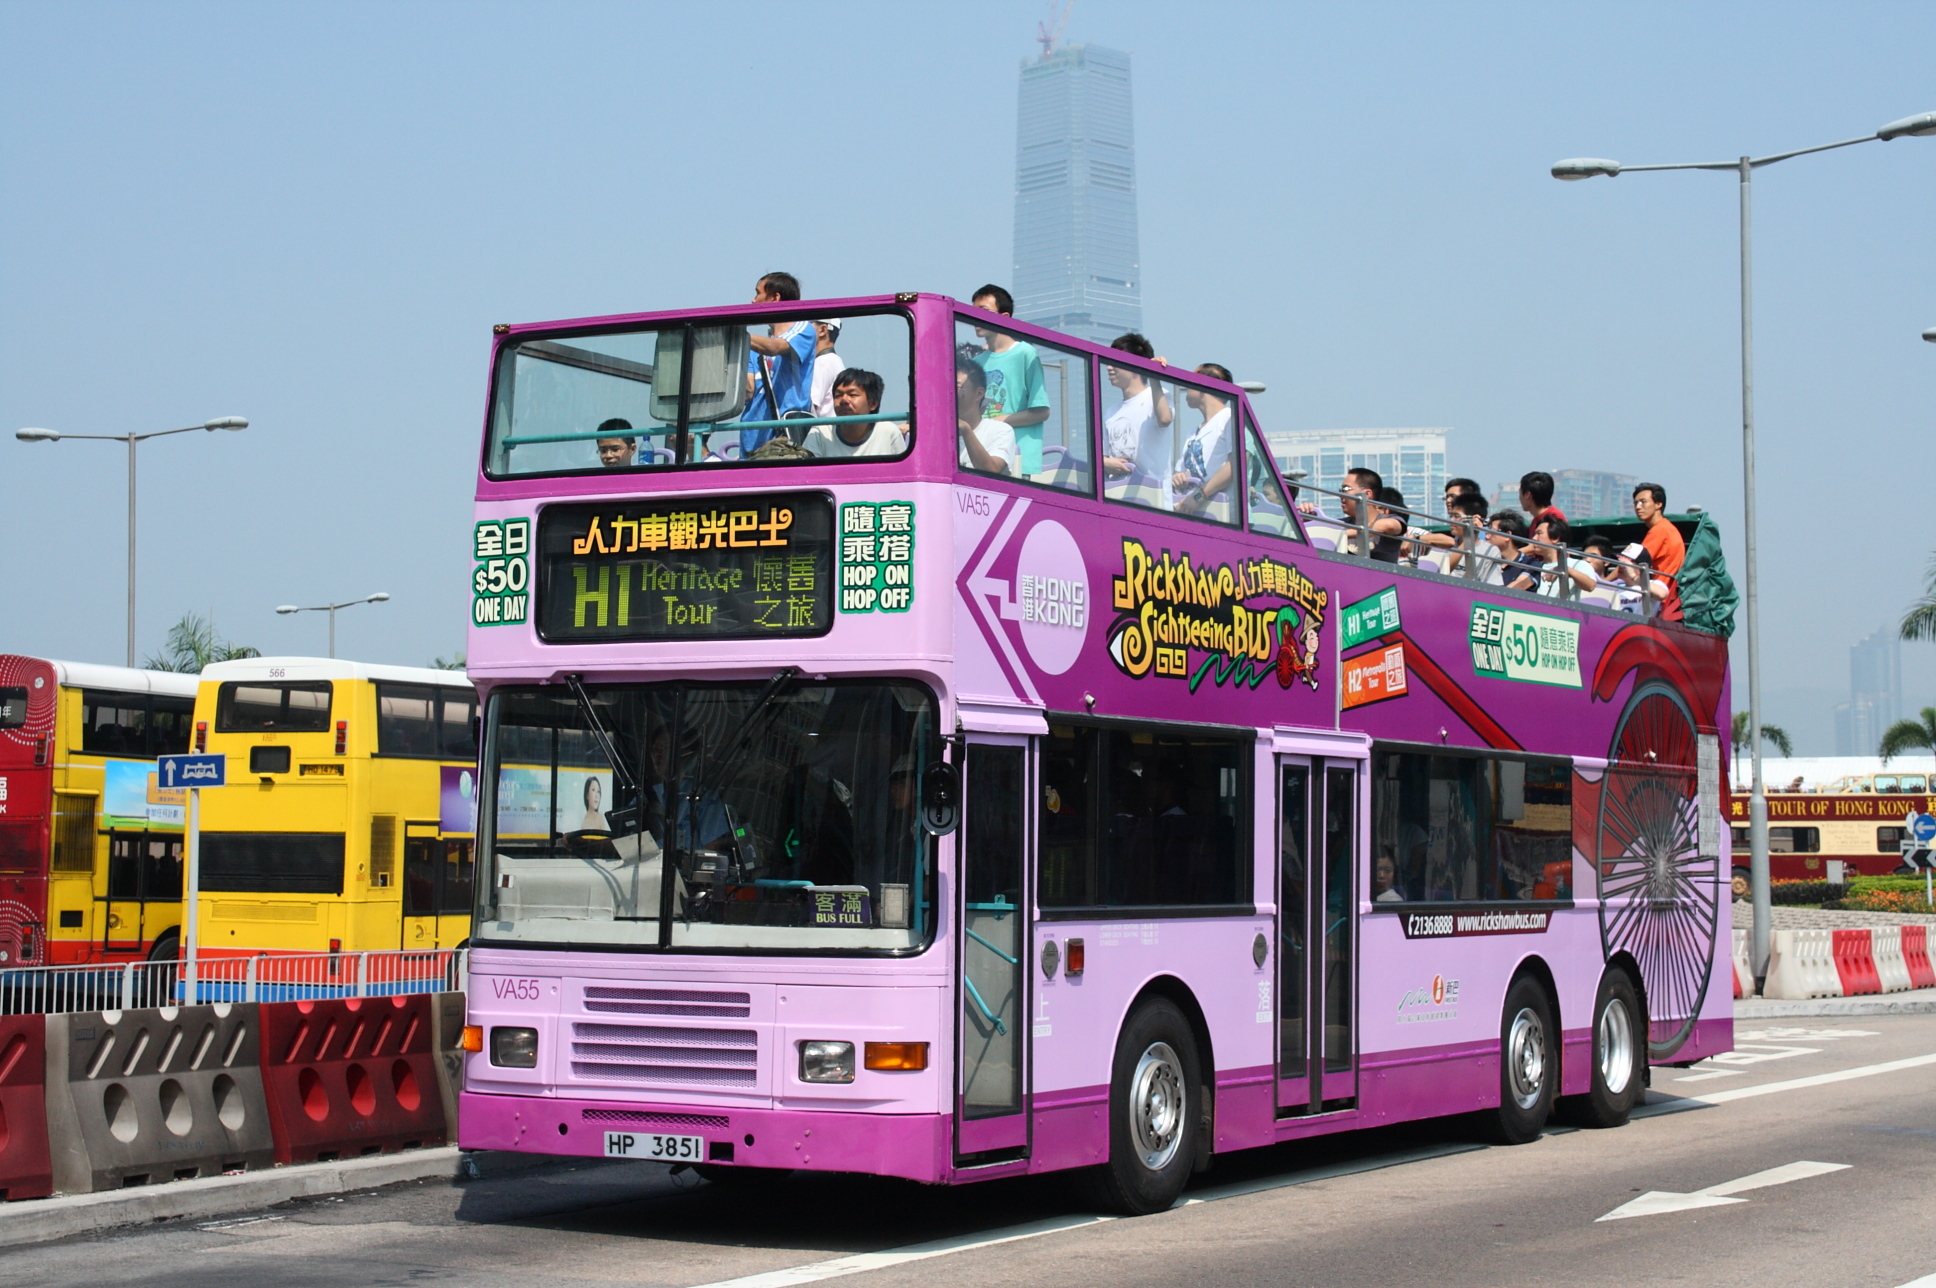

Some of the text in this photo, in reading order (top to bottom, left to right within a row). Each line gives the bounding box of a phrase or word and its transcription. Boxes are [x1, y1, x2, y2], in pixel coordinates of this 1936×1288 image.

[957, 491, 990, 516] VA55
[573, 508, 793, 555] 人力車觀光巴士
[844, 505, 911, 533] 隨意
[477, 522, 528, 557] 全日
[843, 535, 911, 562] 乘搭
[475, 557, 527, 594] $50
[641, 562, 743, 593] Heritage
[843, 565, 909, 586] HOP ON
[1114, 541, 1234, 609] Rickshaw
[843, 588, 910, 609] HOP OFF
[1035, 575, 1084, 604] HONG
[1235, 558, 1328, 622] 人力車觀光巴士
[475, 595, 527, 623] ONE DAY
[663, 596, 718, 625] Tour
[753, 594, 816, 627] 之旅
[1035, 599, 1084, 628] KONG
[1123, 601, 1278, 676] Sightseeing BUS
[1348, 613, 1360, 636] H1
[1471, 607, 1504, 642] 全日
[1472, 642, 1491, 670] ONE
[1505, 623, 1539, 668] $50
[269, 668, 286, 678] 566
[1348, 668, 1362, 693] H2
[1769, 801, 1807, 816] TOUR
[1811, 801, 1829, 816] OF
[1835, 800, 1873, 816] HONG
[1878, 800, 1915, 816] KONG
[815, 893, 862, 913] 客滿
[816, 913, 863, 924] BUS FULL
[1457, 911, 1546, 932] www.rickshawbus.com
[492, 978, 540, 1000] VA55
[1258, 980, 1271, 1011] 落
[1035, 992, 1050, 1021] 上
[608, 1134, 700, 1159] HP 3851
